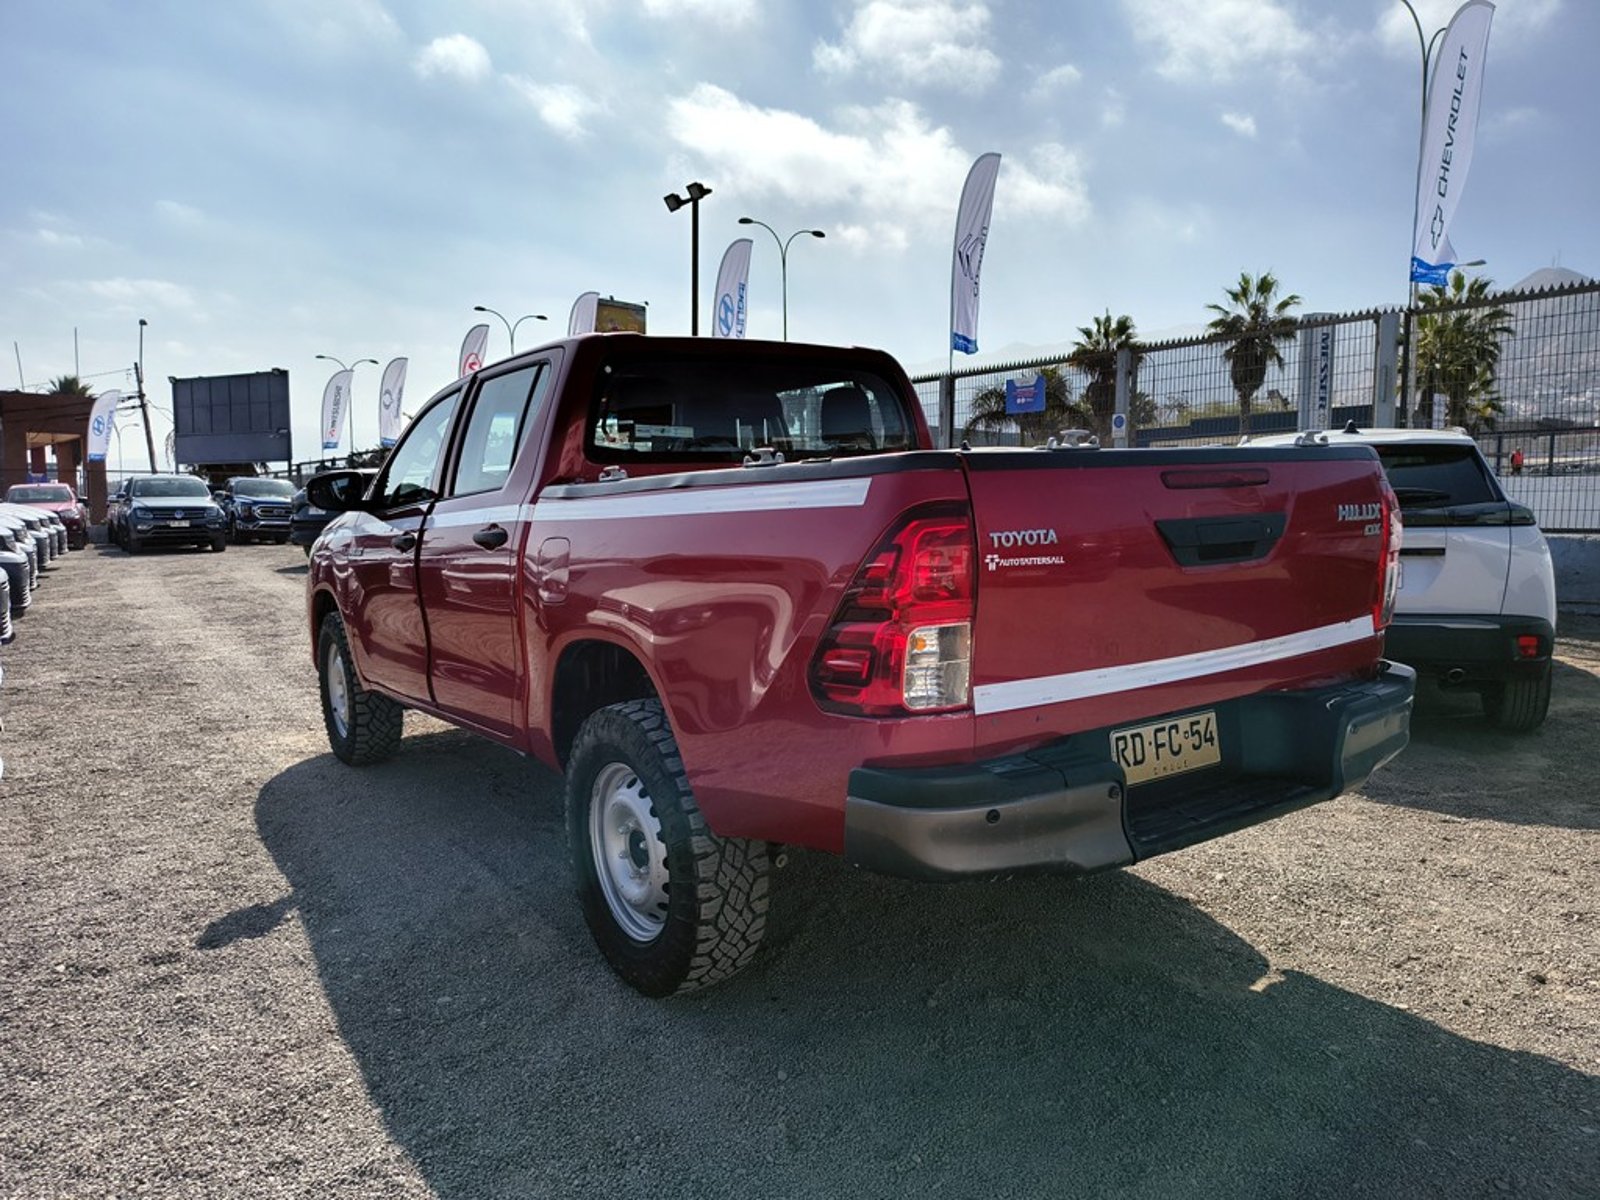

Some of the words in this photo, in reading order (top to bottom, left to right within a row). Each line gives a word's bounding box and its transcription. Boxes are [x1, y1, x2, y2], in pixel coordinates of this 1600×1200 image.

[1437, 45, 1469, 198] CHEVROLET
[1319, 332, 1330, 410] MESSER
[1338, 503, 1381, 521] HILUX
[989, 528, 1058, 548] TOYOTA
